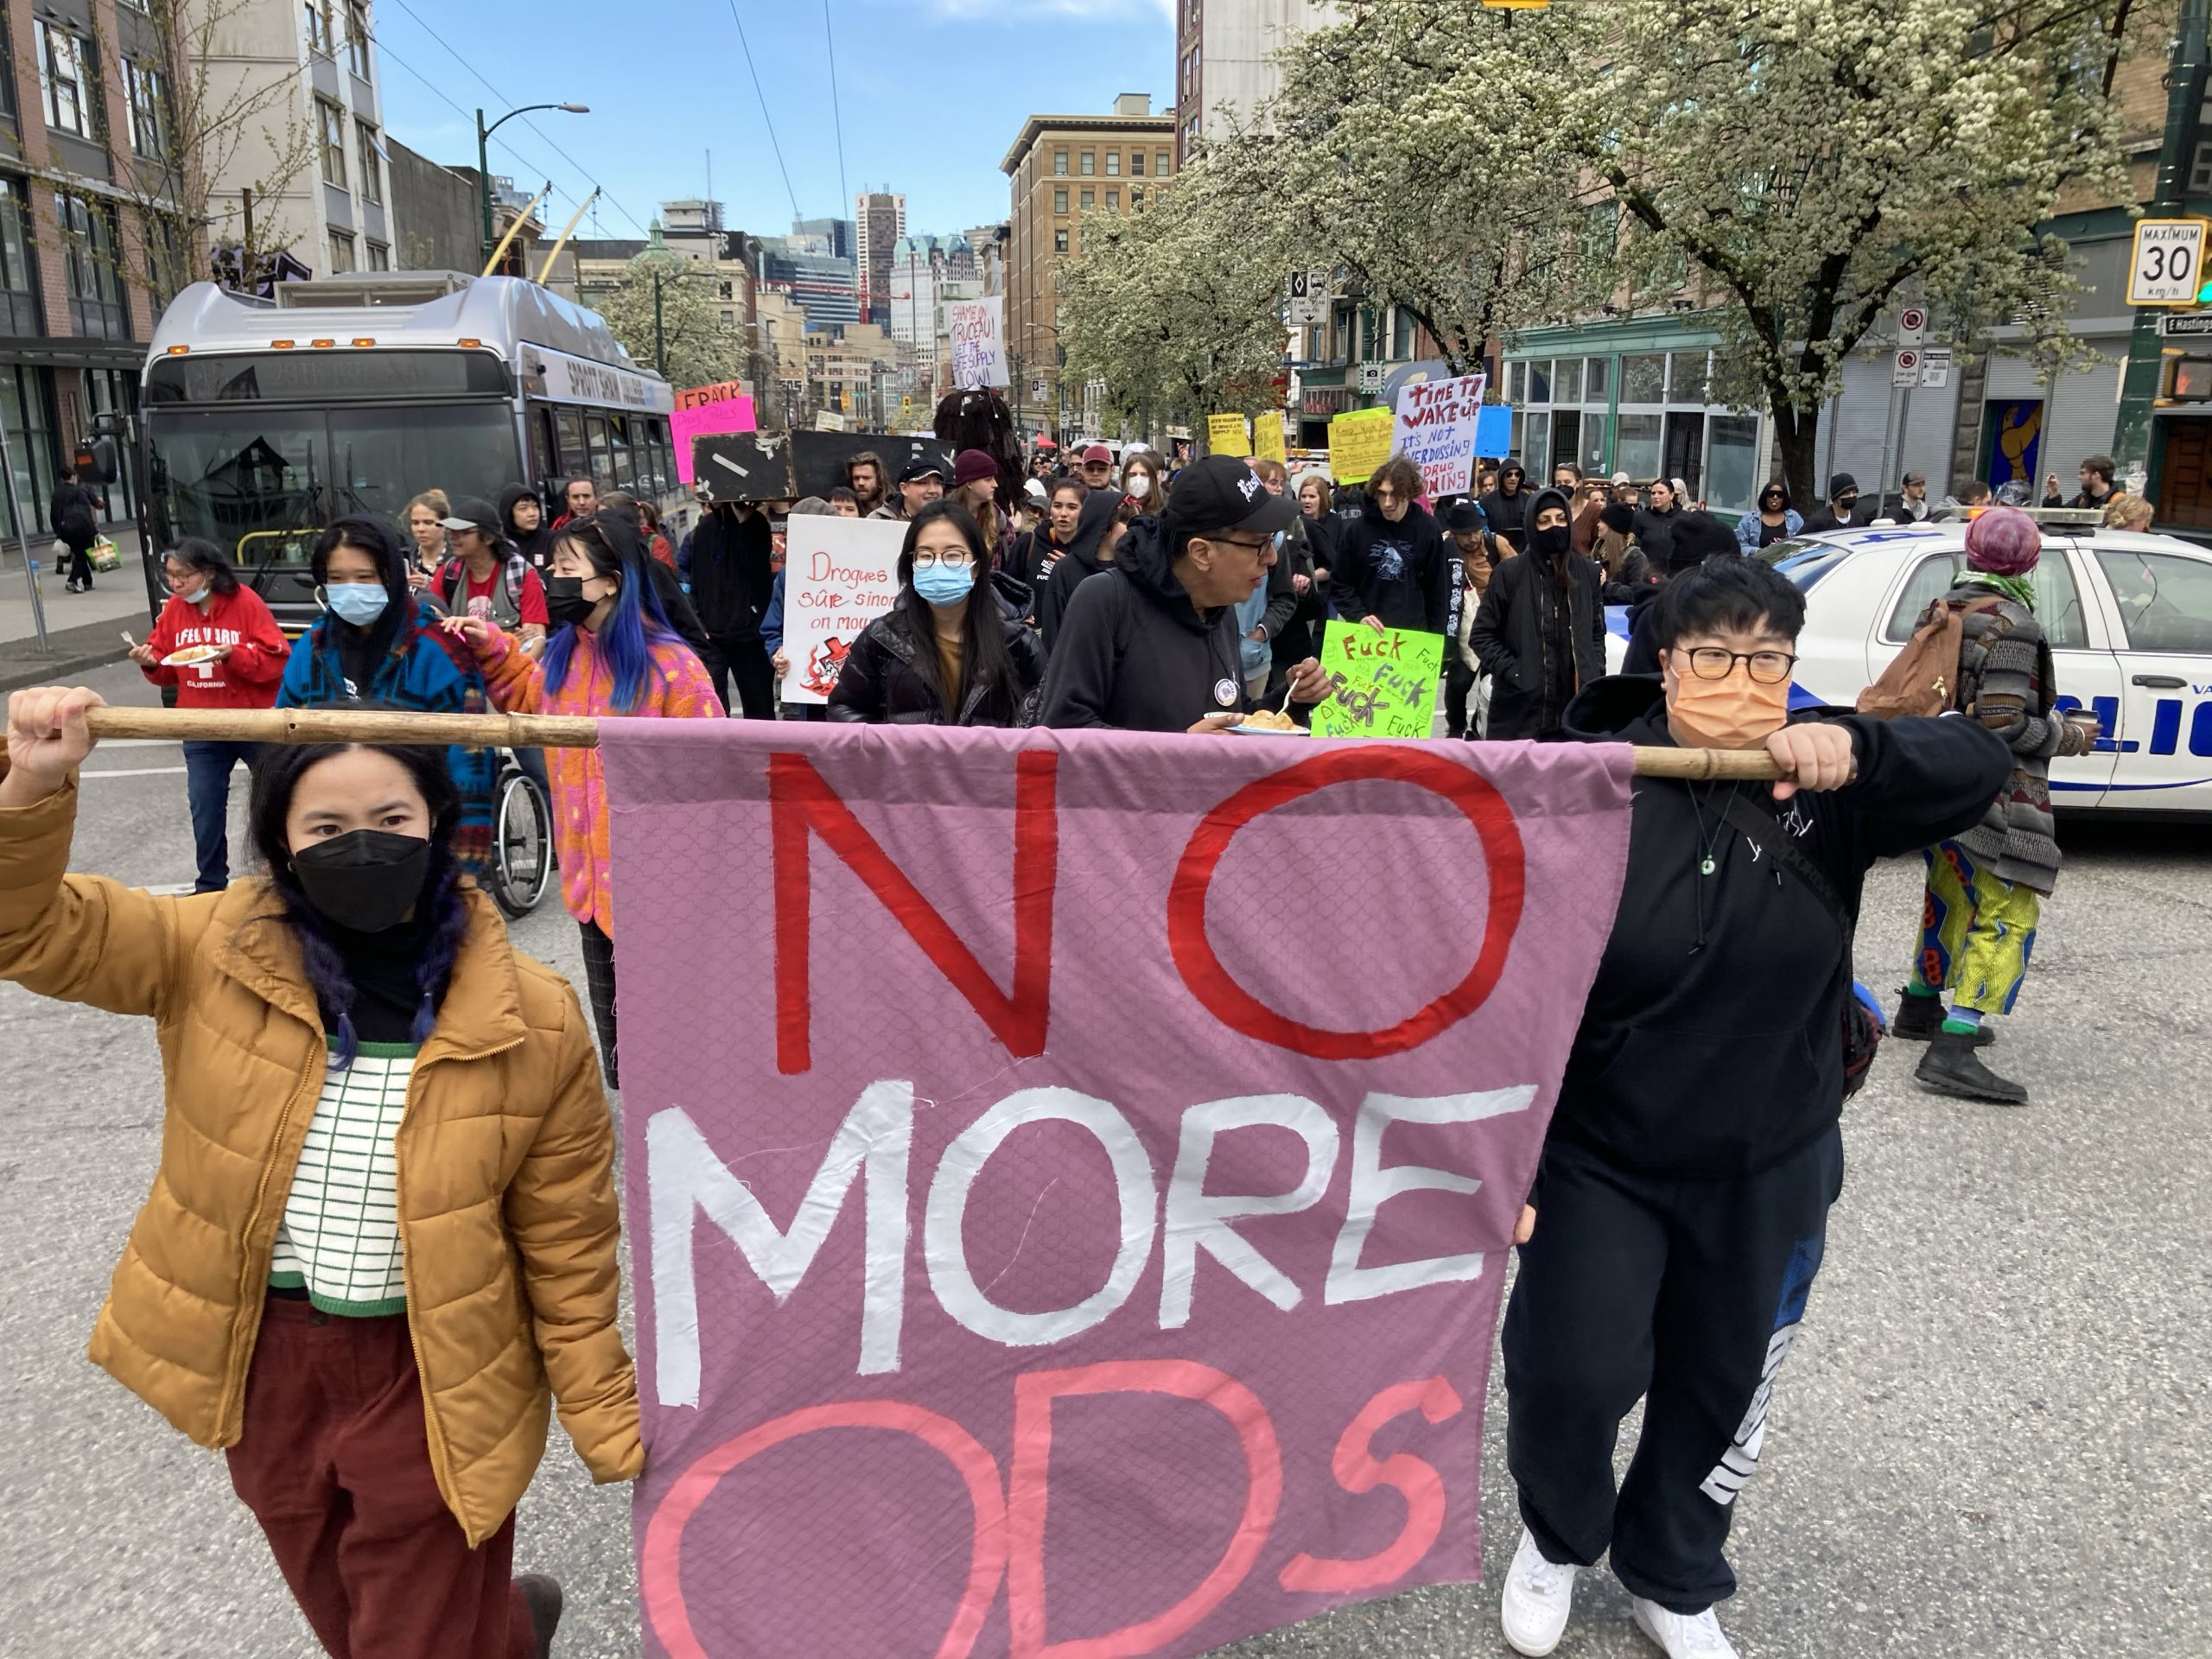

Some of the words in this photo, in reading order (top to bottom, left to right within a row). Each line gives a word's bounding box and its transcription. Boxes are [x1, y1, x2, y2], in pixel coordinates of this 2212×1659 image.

[2144, 228, 2198, 241] MAXIMUM
[2143, 245, 2190, 281] 30
[2148, 287, 2179, 296] km/h
[952, 304, 977, 322] SHAME
[977, 305, 988, 319] ON
[951, 315, 995, 343] TRUDEAU!
[2169, 319, 2176, 332] E
[955, 342, 967, 356] LET
[969, 340, 980, 353] THE
[969, 350, 995, 369] SUPPLY
[566, 360, 600, 399] SPROTT
[1401, 401, 1459, 429] WAKE
[807, 551, 888, 589] Drogues
[798, 588, 851, 609] sûre
[810, 616, 830, 630] on
[187, 680, 226, 689] CALIFORNIA
[769, 744, 1526, 1075] NO
[645, 1079, 1539, 1408] MORE
